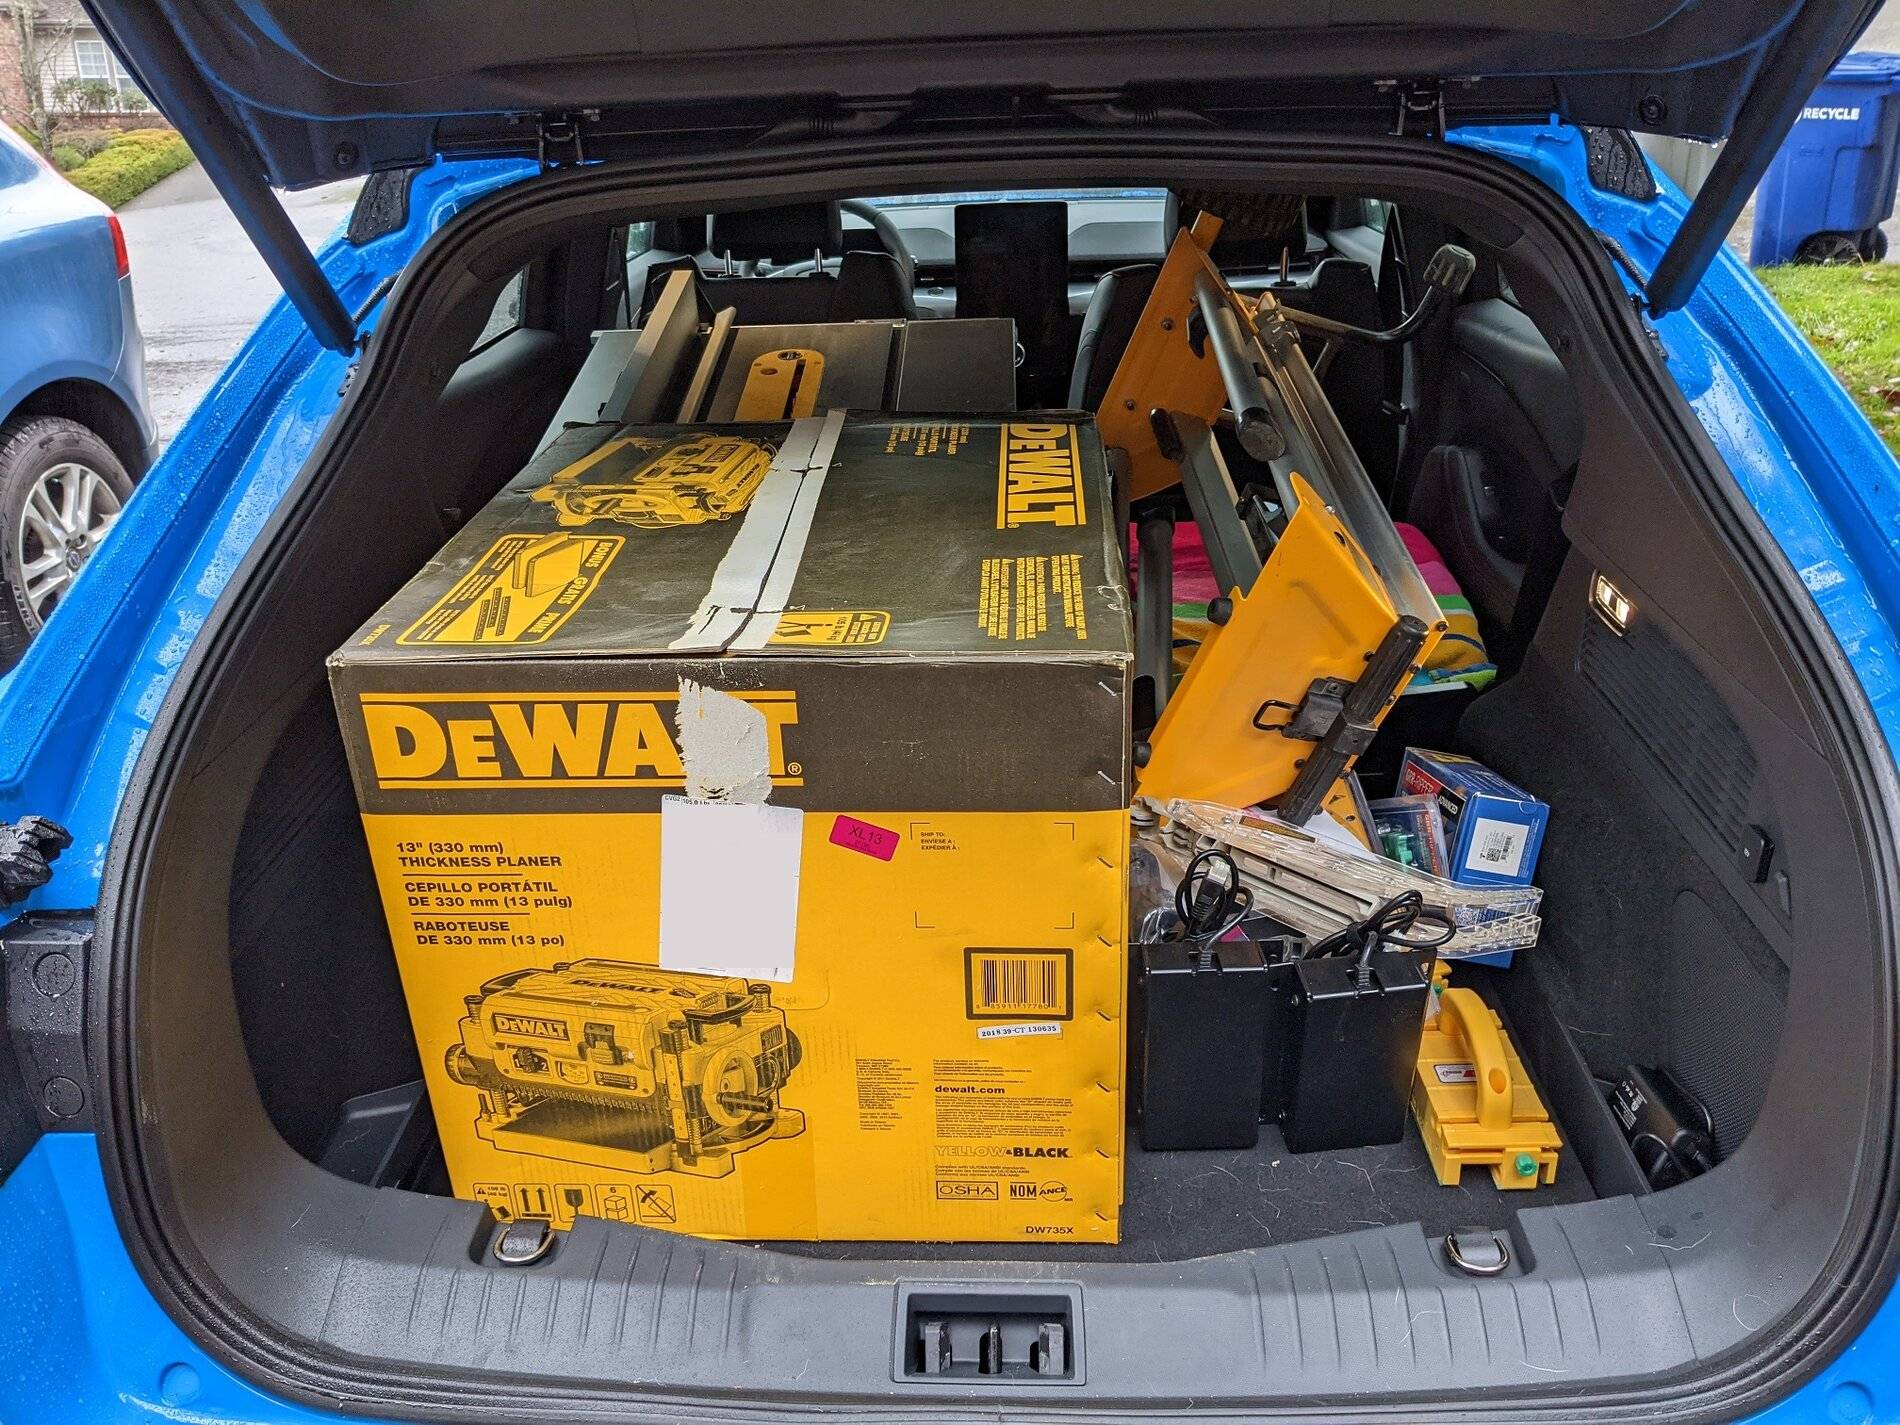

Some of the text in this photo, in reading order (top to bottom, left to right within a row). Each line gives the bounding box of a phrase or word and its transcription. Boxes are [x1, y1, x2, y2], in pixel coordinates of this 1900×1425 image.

[1803, 107, 1860, 120] RECYCLE
[527, 542, 613, 633] BONUS GRATIS PRIME
[362, 702, 800, 779] DEWAT
[848, 825, 883, 845] XL13
[396, 842, 504, 855] 13" (330 mm)
[398, 856, 562, 867] THICKNESS PLANER
[405, 880, 558, 893] CEPILLO PORTÁTIL
[408, 896, 572, 909] DE 330 mm (13 pulg)
[414, 921, 510, 931] RABOTEUSE
[417, 935, 565, 947] DE 330 mm (13 po)
[496, 1017, 566, 1037] DEWALT
[982, 1028, 1001, 1037] 2018
[935, 1085, 1006, 1094] dewalt.com
[939, 1185, 1068, 1197] OSHA NOM ANCE
[1025, 1226, 1074, 1234] DW735X
